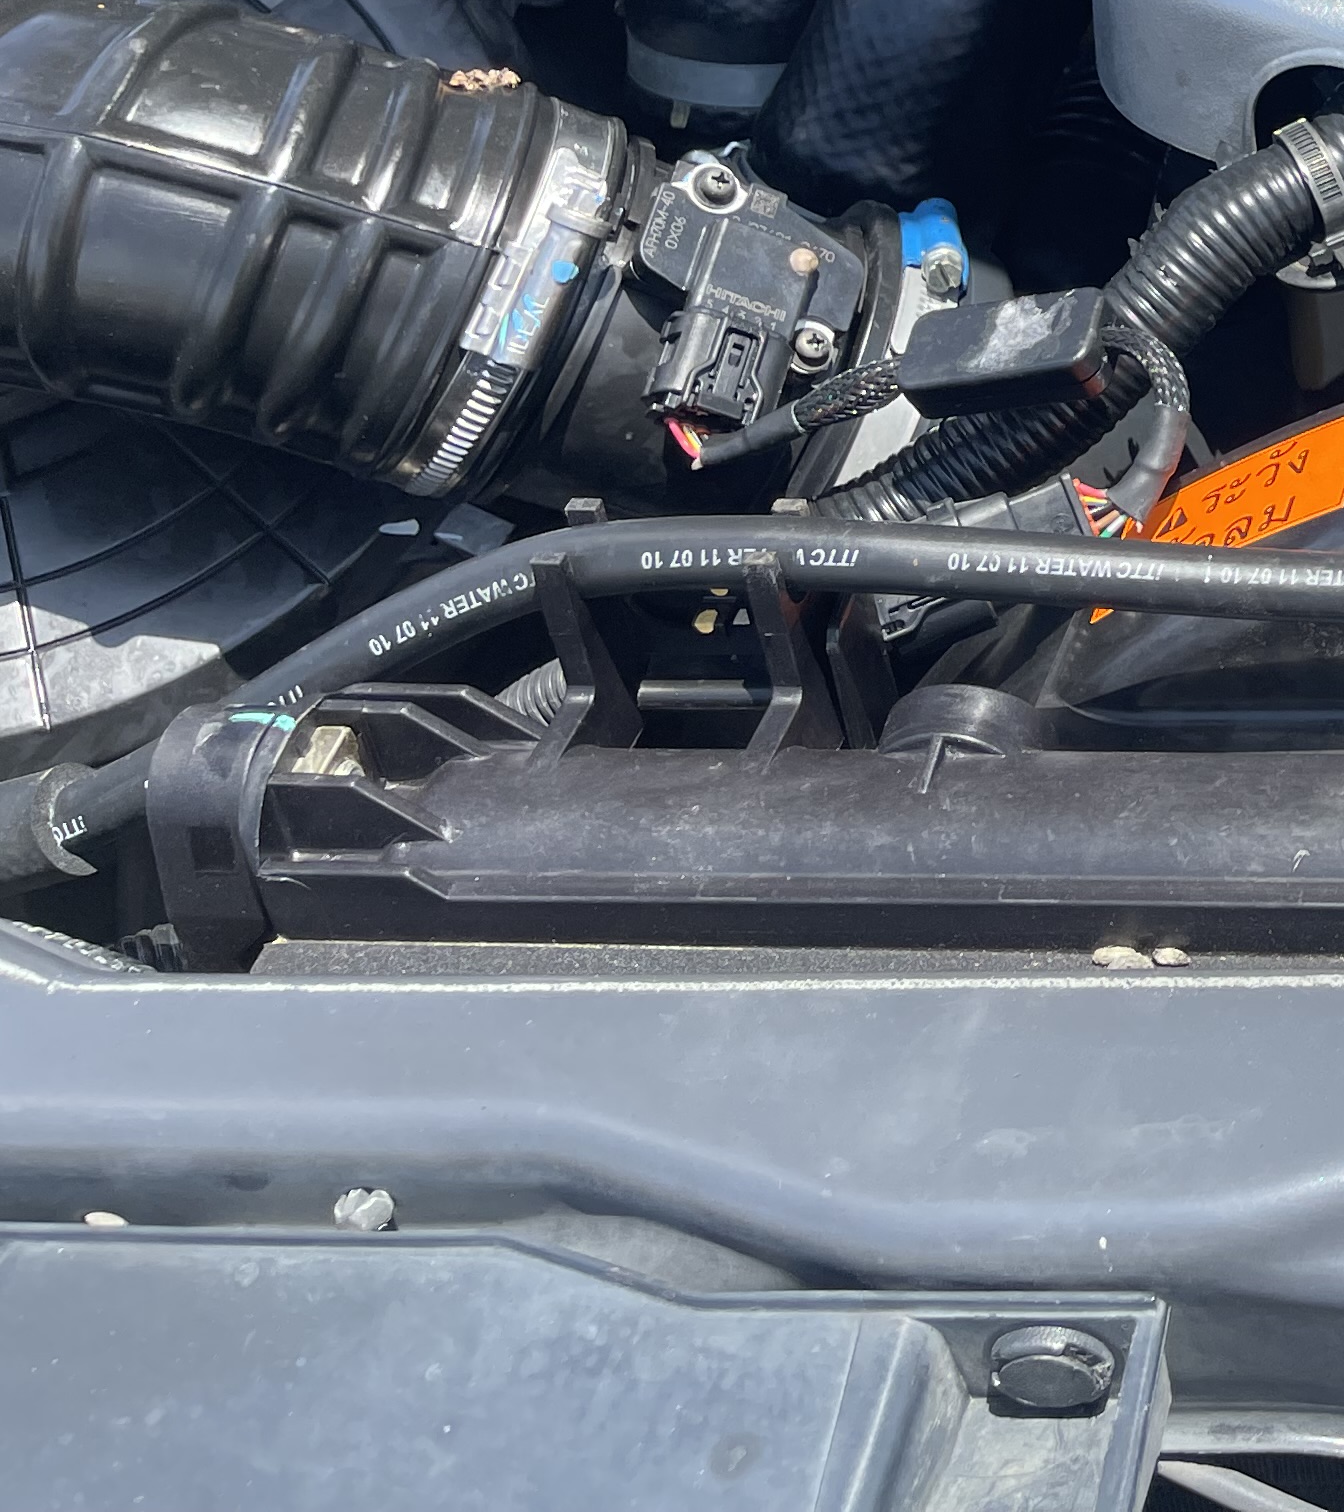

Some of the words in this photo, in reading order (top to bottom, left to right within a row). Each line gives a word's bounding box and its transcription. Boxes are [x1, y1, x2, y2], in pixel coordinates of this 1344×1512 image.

[705, 284, 787, 322] HITACHI
[641, 550, 664, 570] 10
[669, 549, 693, 568] 07
[700, 548, 722, 567] 11
[947, 552, 971, 573] 10
[975, 553, 1002, 573] 07
[1007, 556, 1029, 574] 11
[1034, 555, 1111, 579] WATER
[1219, 566, 1241, 584] 10
[1247, 567, 1272, 586] 07
[1278, 568, 1299, 586] 11
[440, 577, 510, 620] WATER
[394, 620, 417, 646] 07
[367, 634, 393, 657] 10
